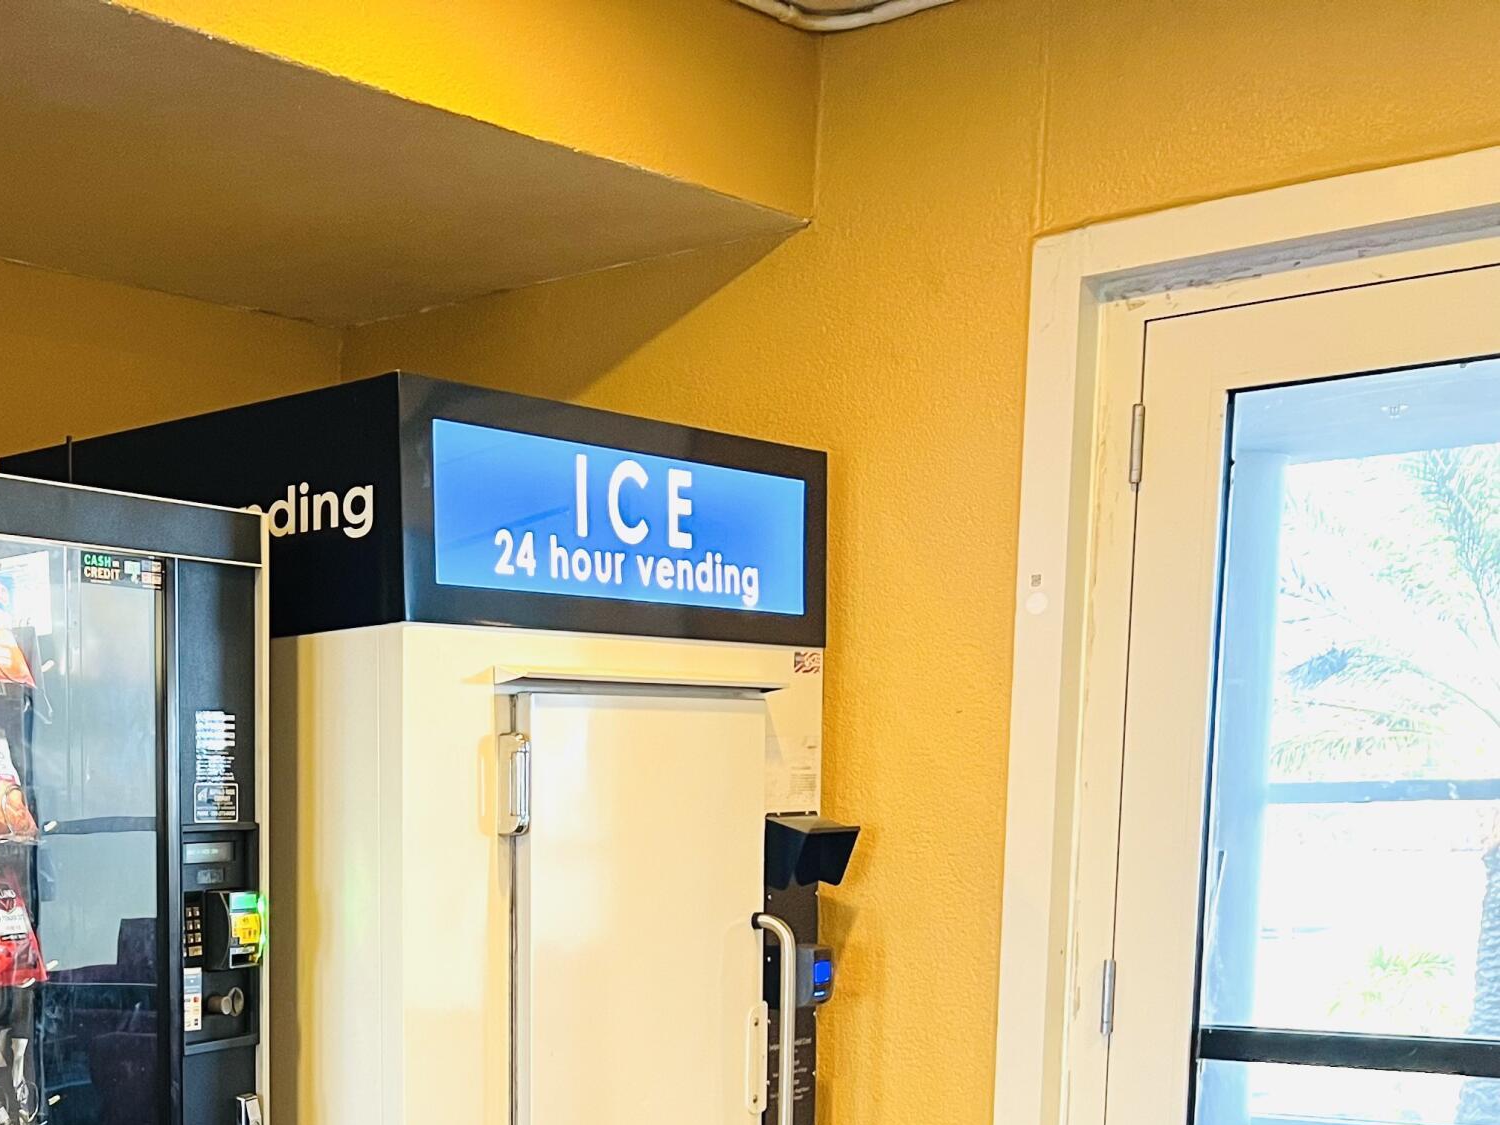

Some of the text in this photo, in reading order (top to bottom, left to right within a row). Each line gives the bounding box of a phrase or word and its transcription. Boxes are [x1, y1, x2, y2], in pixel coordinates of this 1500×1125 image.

[575, 453, 693, 549] ICE
[83, 553, 112, 568] CASH
[83, 566, 121, 581] CREDIT
[494, 528, 761, 607] 24 hour vending
